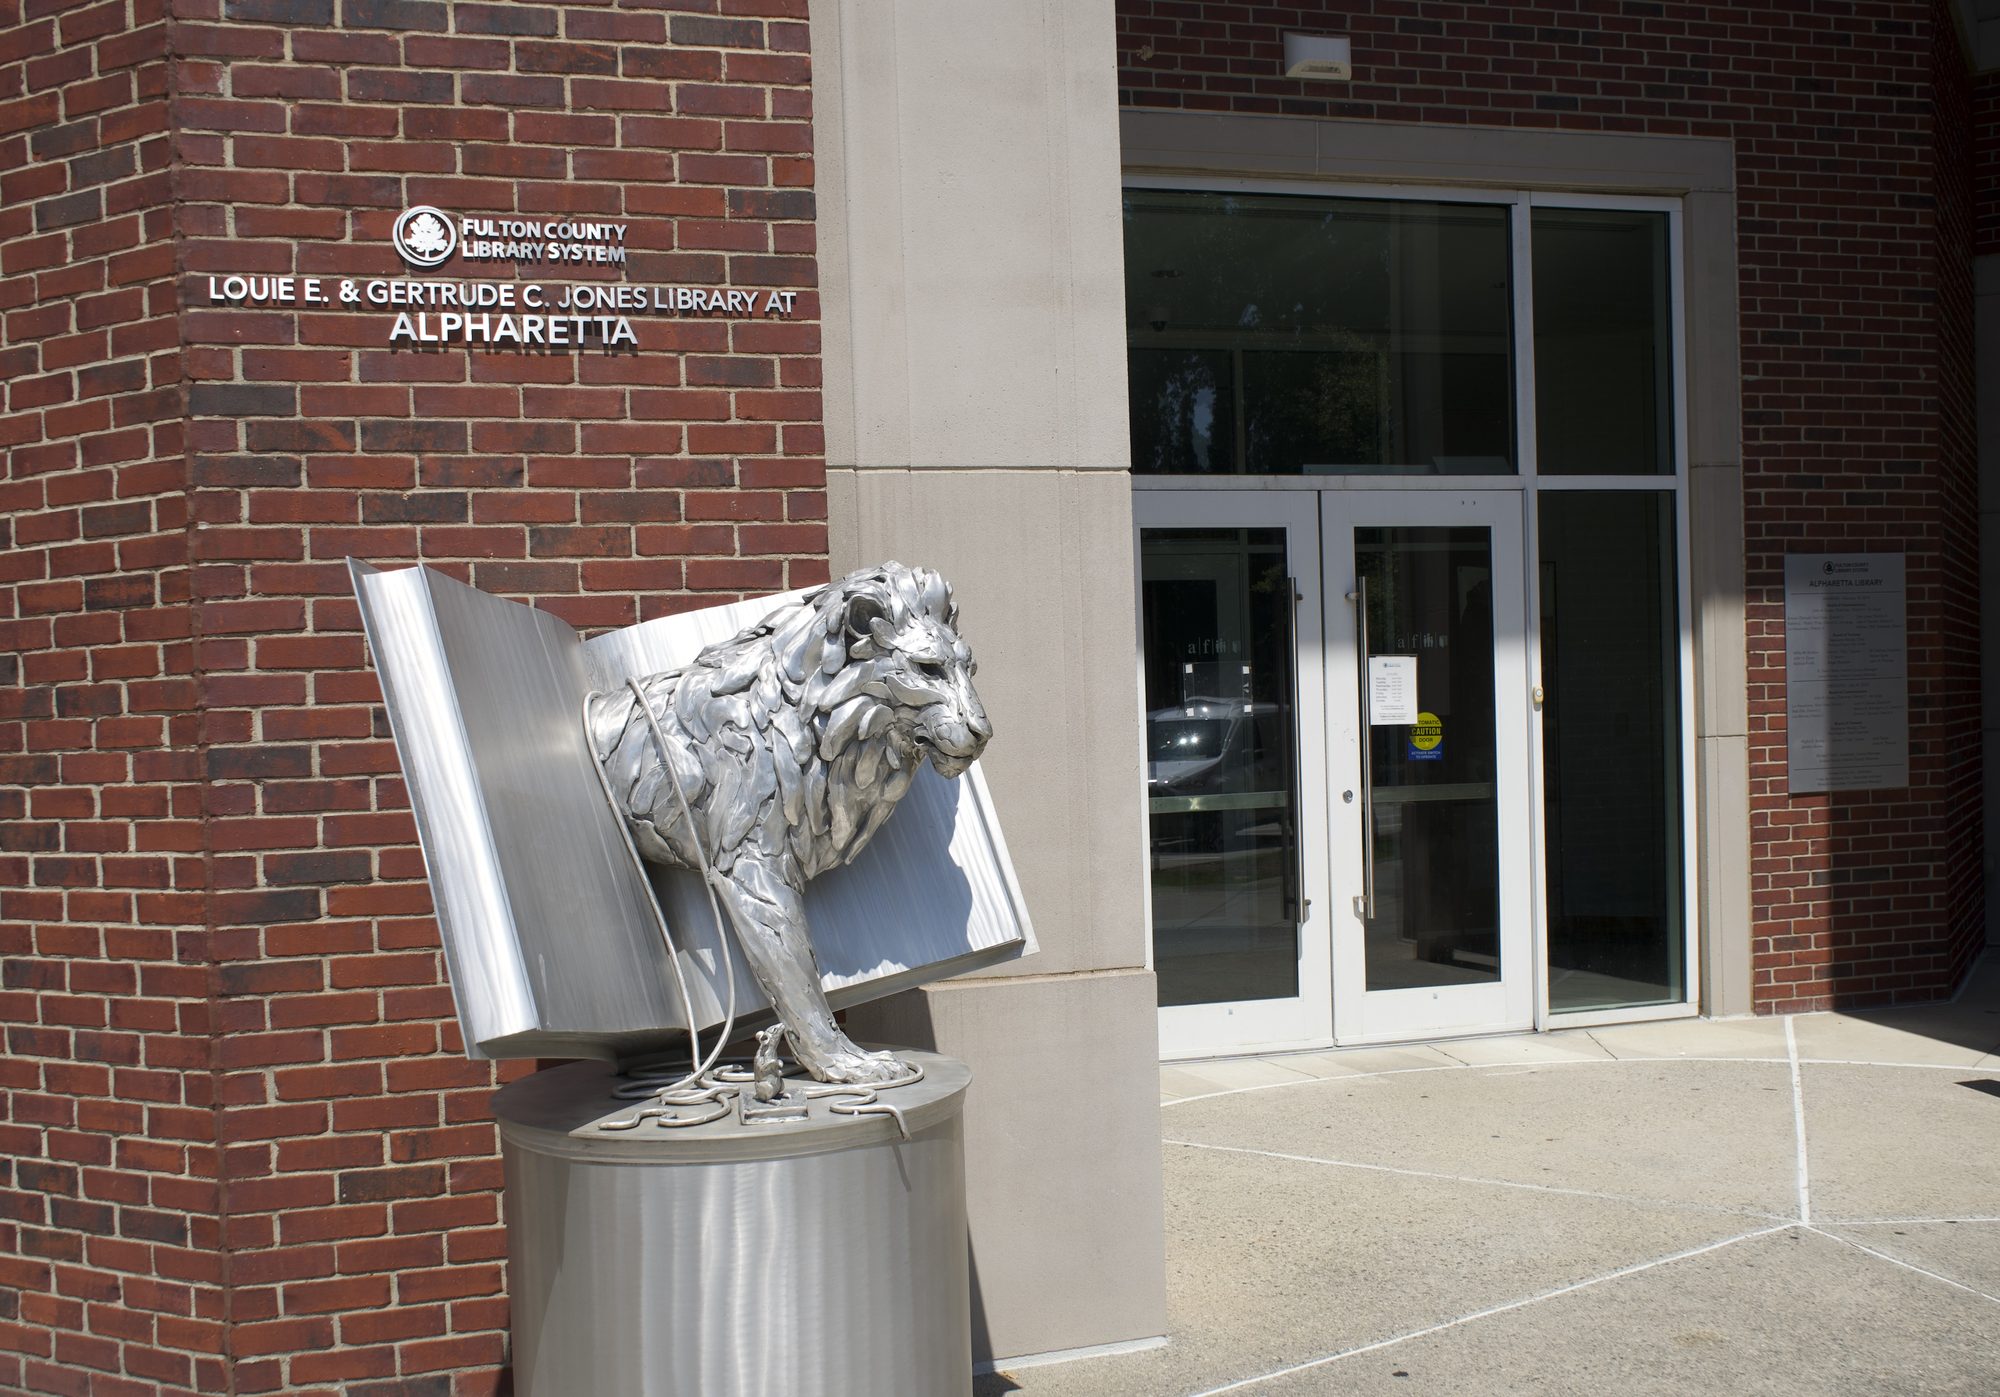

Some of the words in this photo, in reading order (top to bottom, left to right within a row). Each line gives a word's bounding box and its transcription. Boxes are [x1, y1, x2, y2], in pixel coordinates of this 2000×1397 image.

[462, 218, 541, 239] FULTON
[543, 222, 627, 241] COUNTY
[462, 240, 545, 260] LIBRARY
[547, 242, 626, 263] SYSTEM
[208, 276, 295, 301] LOUIE
[304, 278, 329, 303] E.
[338, 279, 362, 303] &
[366, 280, 515, 308] GERTRUDE
[522, 284, 551, 309] C.
[557, 286, 648, 311] JONES
[653, 287, 758, 313] LIBRARY
[764, 291, 797, 314] AT
[388, 311, 638, 345] ALPHARETTA
[1808, 580, 1854, 588] ALPHARETTA
[1855, 579, 1883, 587] LIBRARY
[1411, 727, 1441, 736] CAUTION
